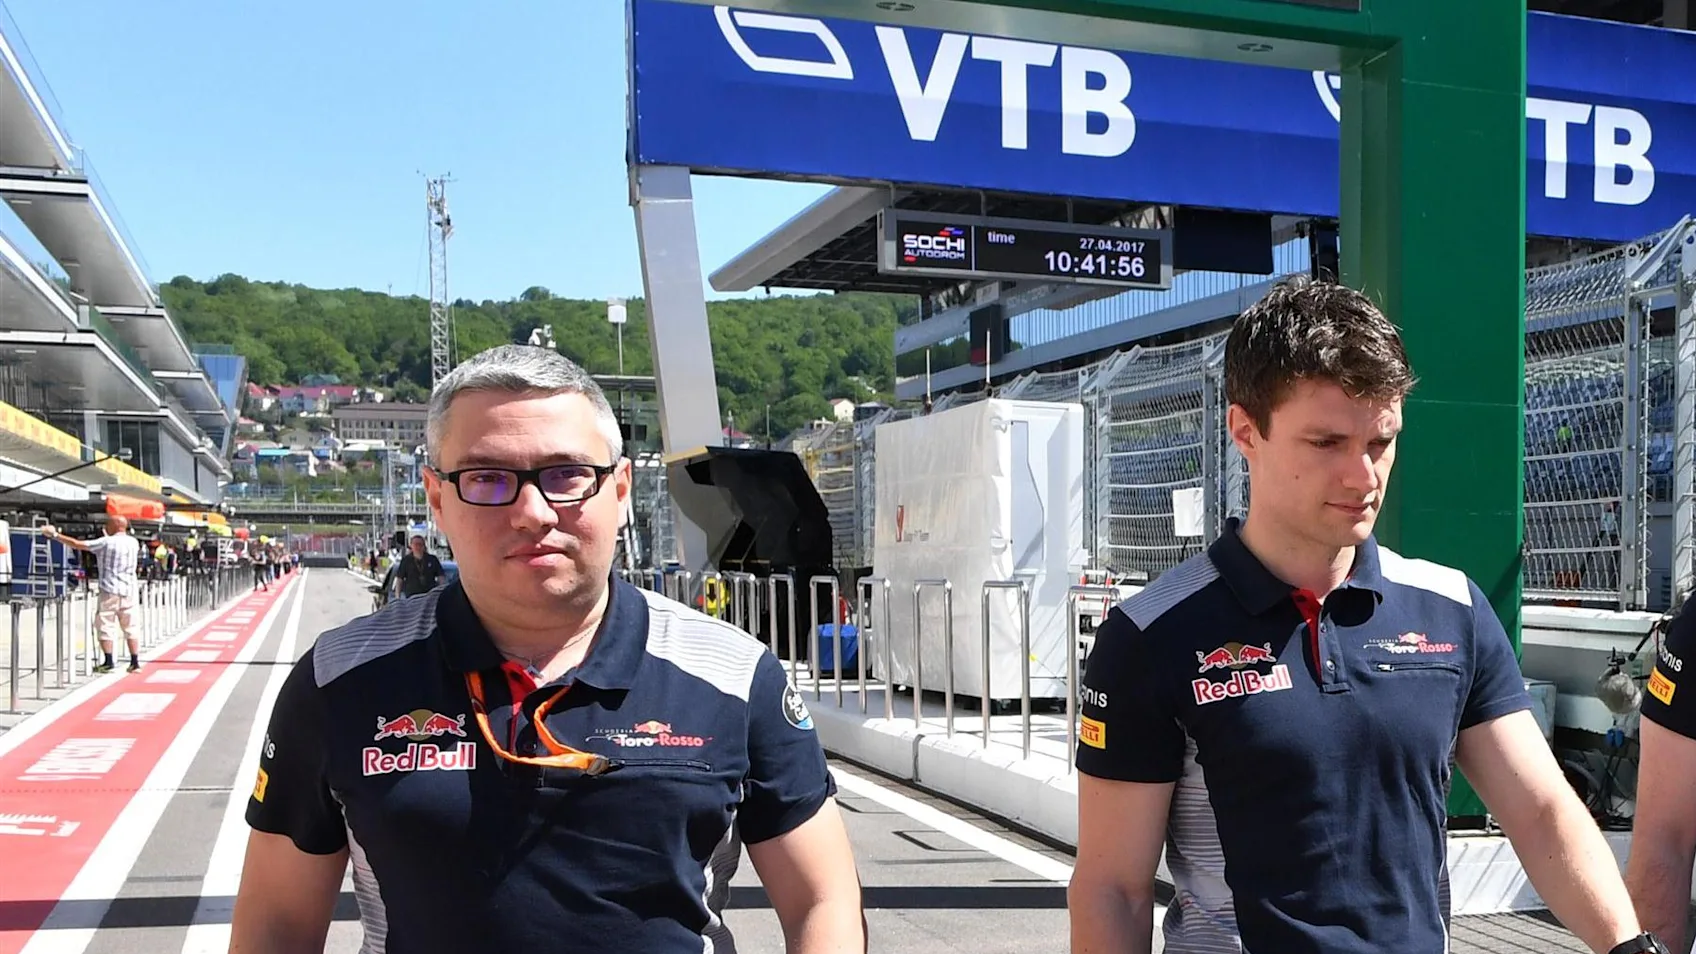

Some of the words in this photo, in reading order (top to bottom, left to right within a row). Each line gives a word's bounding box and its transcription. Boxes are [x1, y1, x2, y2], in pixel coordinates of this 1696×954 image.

[874, 25, 1137, 158] VTB
[1525, 97, 1655, 206] TB
[903, 234, 965, 251] SOCHI
[987, 231, 1016, 244] time
[1079, 237, 1146, 254] 27.04.2017
[903, 248, 965, 260] AUTODROM
[1044, 251, 1146, 277] 10:41:56
[1418, 642, 1453, 653] Rosso
[1192, 671, 1243, 705] Red
[1243, 664, 1293, 695] Bull
[613, 733, 656, 747] Toro
[658, 733, 704, 747] Rosso
[363, 743, 418, 776] Red
[417, 742, 476, 771] Bull
